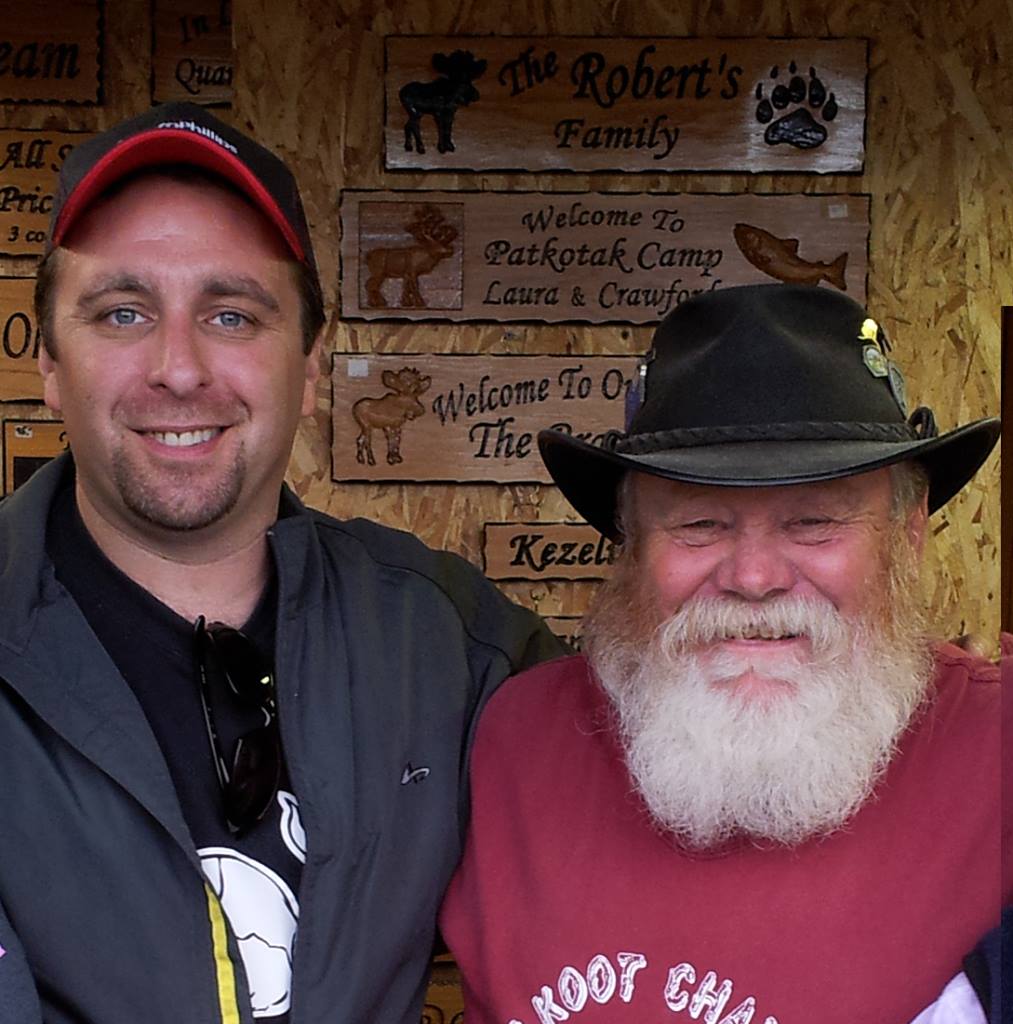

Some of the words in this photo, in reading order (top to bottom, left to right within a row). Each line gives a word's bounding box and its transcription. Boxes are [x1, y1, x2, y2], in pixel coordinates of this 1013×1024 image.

[500, 46, 559, 97] The
[570, 46, 744, 108] Robert's
[554, 115, 680, 159] Family
[8, 226, 19, 242] 3
[521, 202, 642, 233] Welcome
[652, 207, 685, 233] To
[484, 237, 634, 274] Patkotak
[637, 242, 723, 277] Camp
[483, 280, 559, 307] Laura
[570, 286, 586, 307] &
[433, 375, 550, 426] Welcome
[558, 365, 591, 400] To
[468, 417, 532, 459] The
